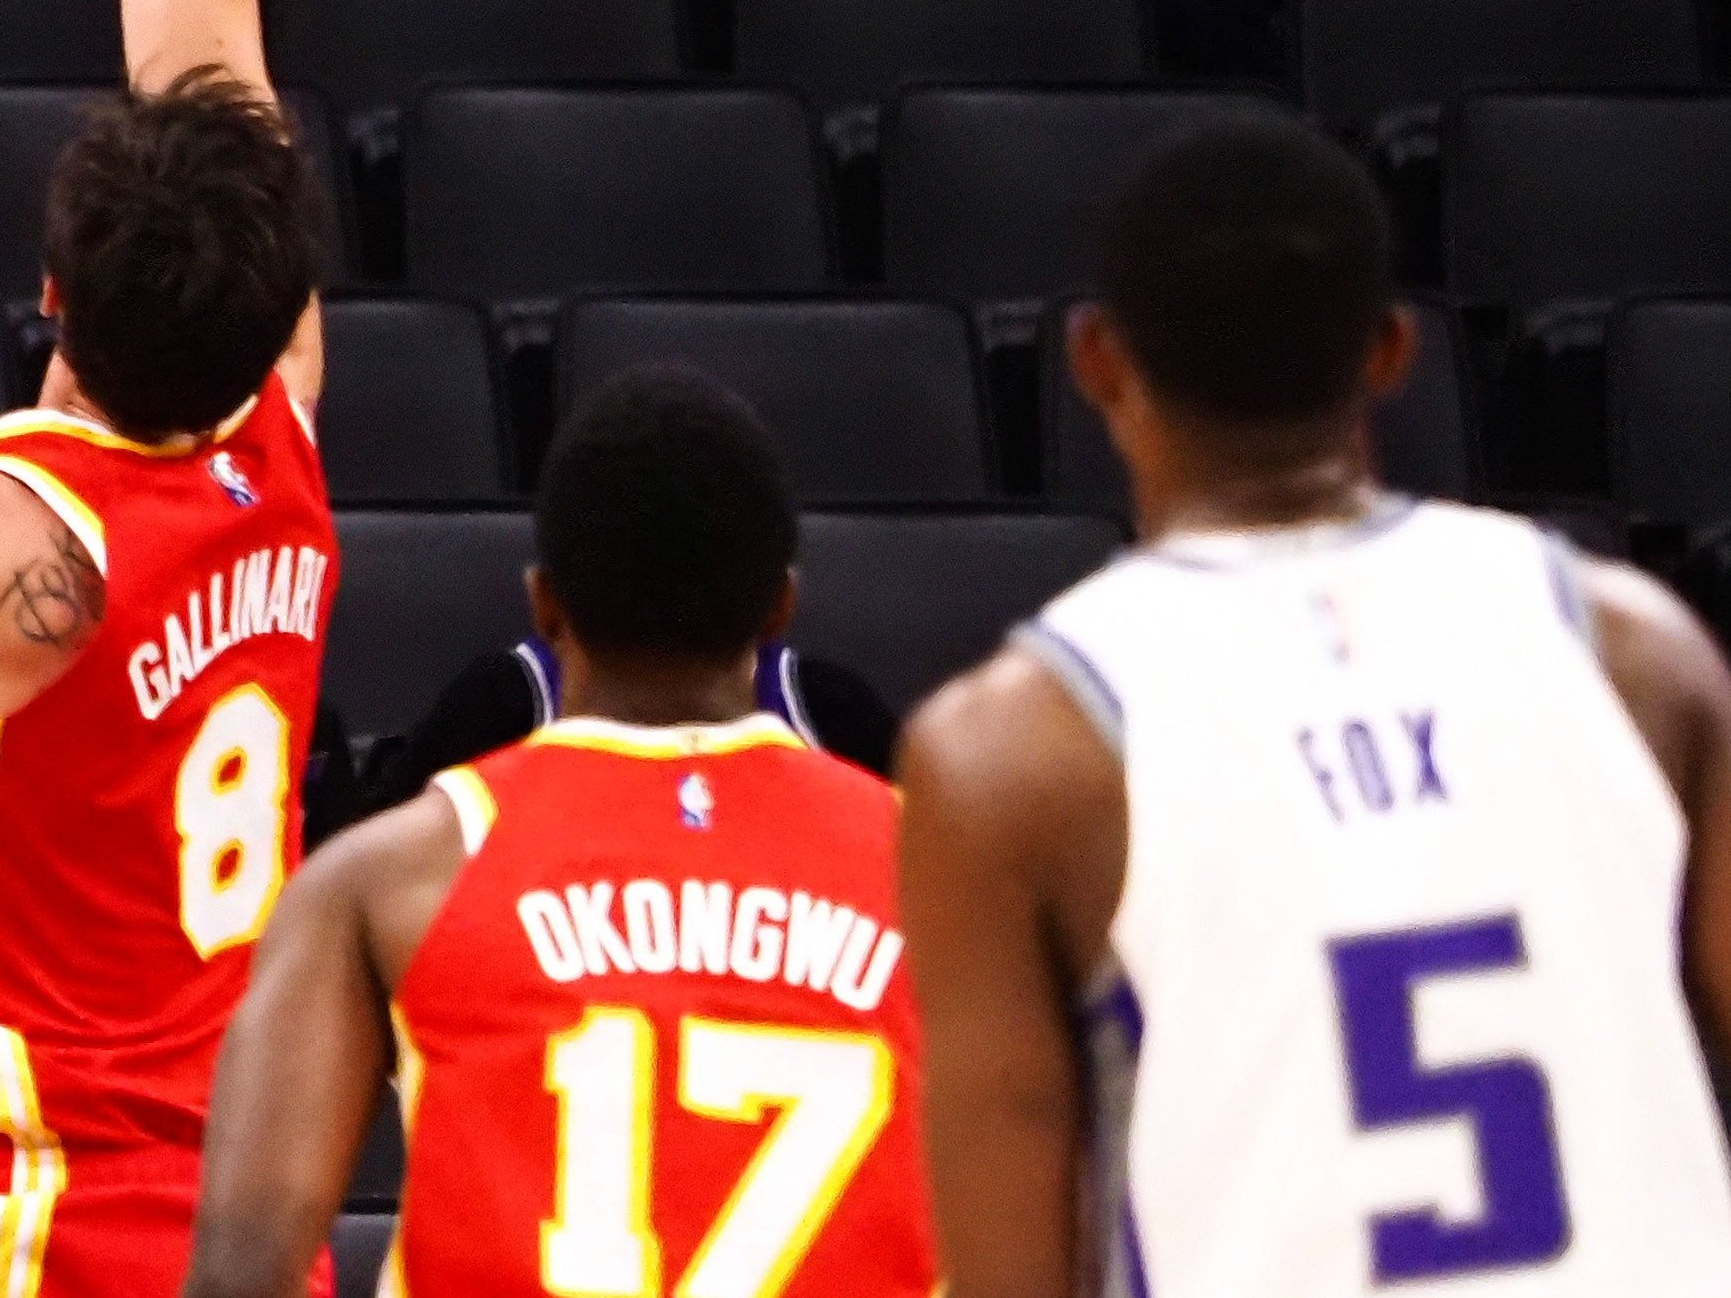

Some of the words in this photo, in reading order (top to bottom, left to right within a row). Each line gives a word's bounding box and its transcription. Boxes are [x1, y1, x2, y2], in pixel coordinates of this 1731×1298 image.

[127, 545, 328, 721] GALLINARI
[173, 682, 292, 962] 8
[1290, 706, 1450, 826] FOX
[515, 878, 908, 1012] OKONGWU
[538, 1001, 899, 1298] 17
[1320, 905, 1578, 1294] 5
